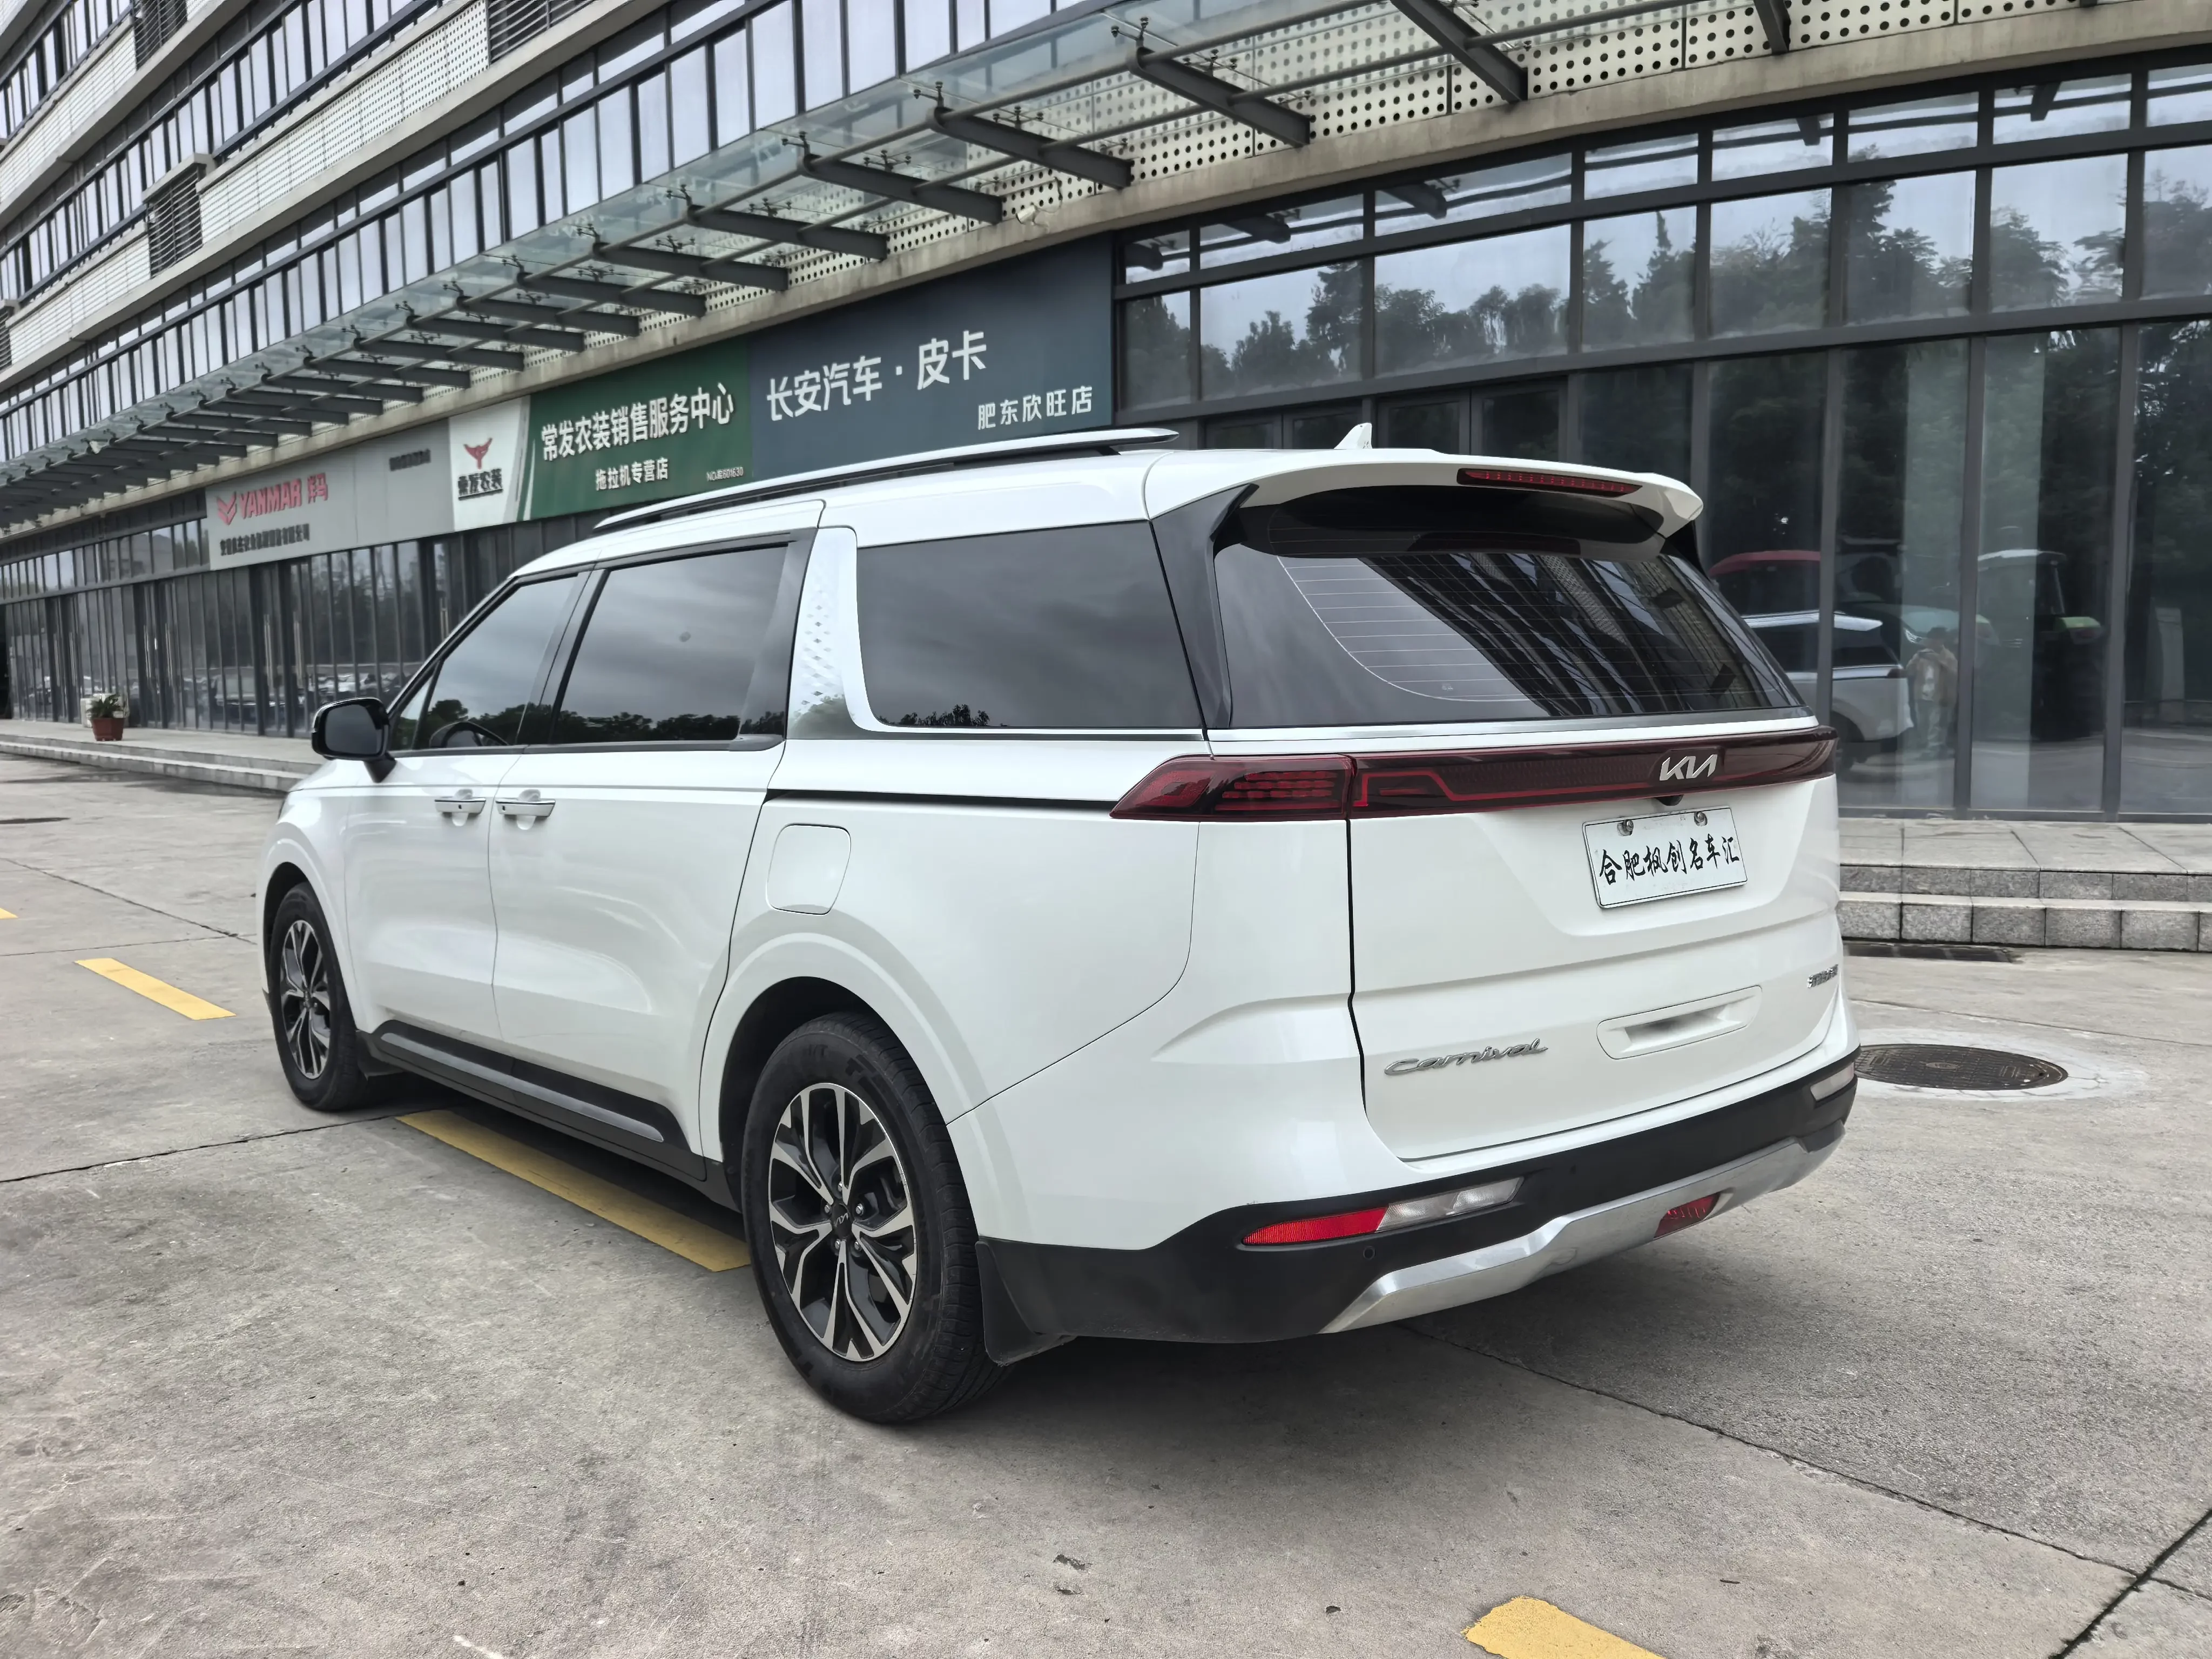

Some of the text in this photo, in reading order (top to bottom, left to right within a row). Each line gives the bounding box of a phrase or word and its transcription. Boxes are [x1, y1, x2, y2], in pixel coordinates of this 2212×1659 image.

[541, 382, 734, 461] 常发农装销售服务中心
[977, 386, 1092, 430] 肥东欣旺店
[595, 456, 669, 491] 拖拉机专营店
[239, 478, 302, 520] YANMAR
[1599, 833, 1740, 886] 合肥枫创名车汇
[1384, 1037, 1549, 1076] Carnival
